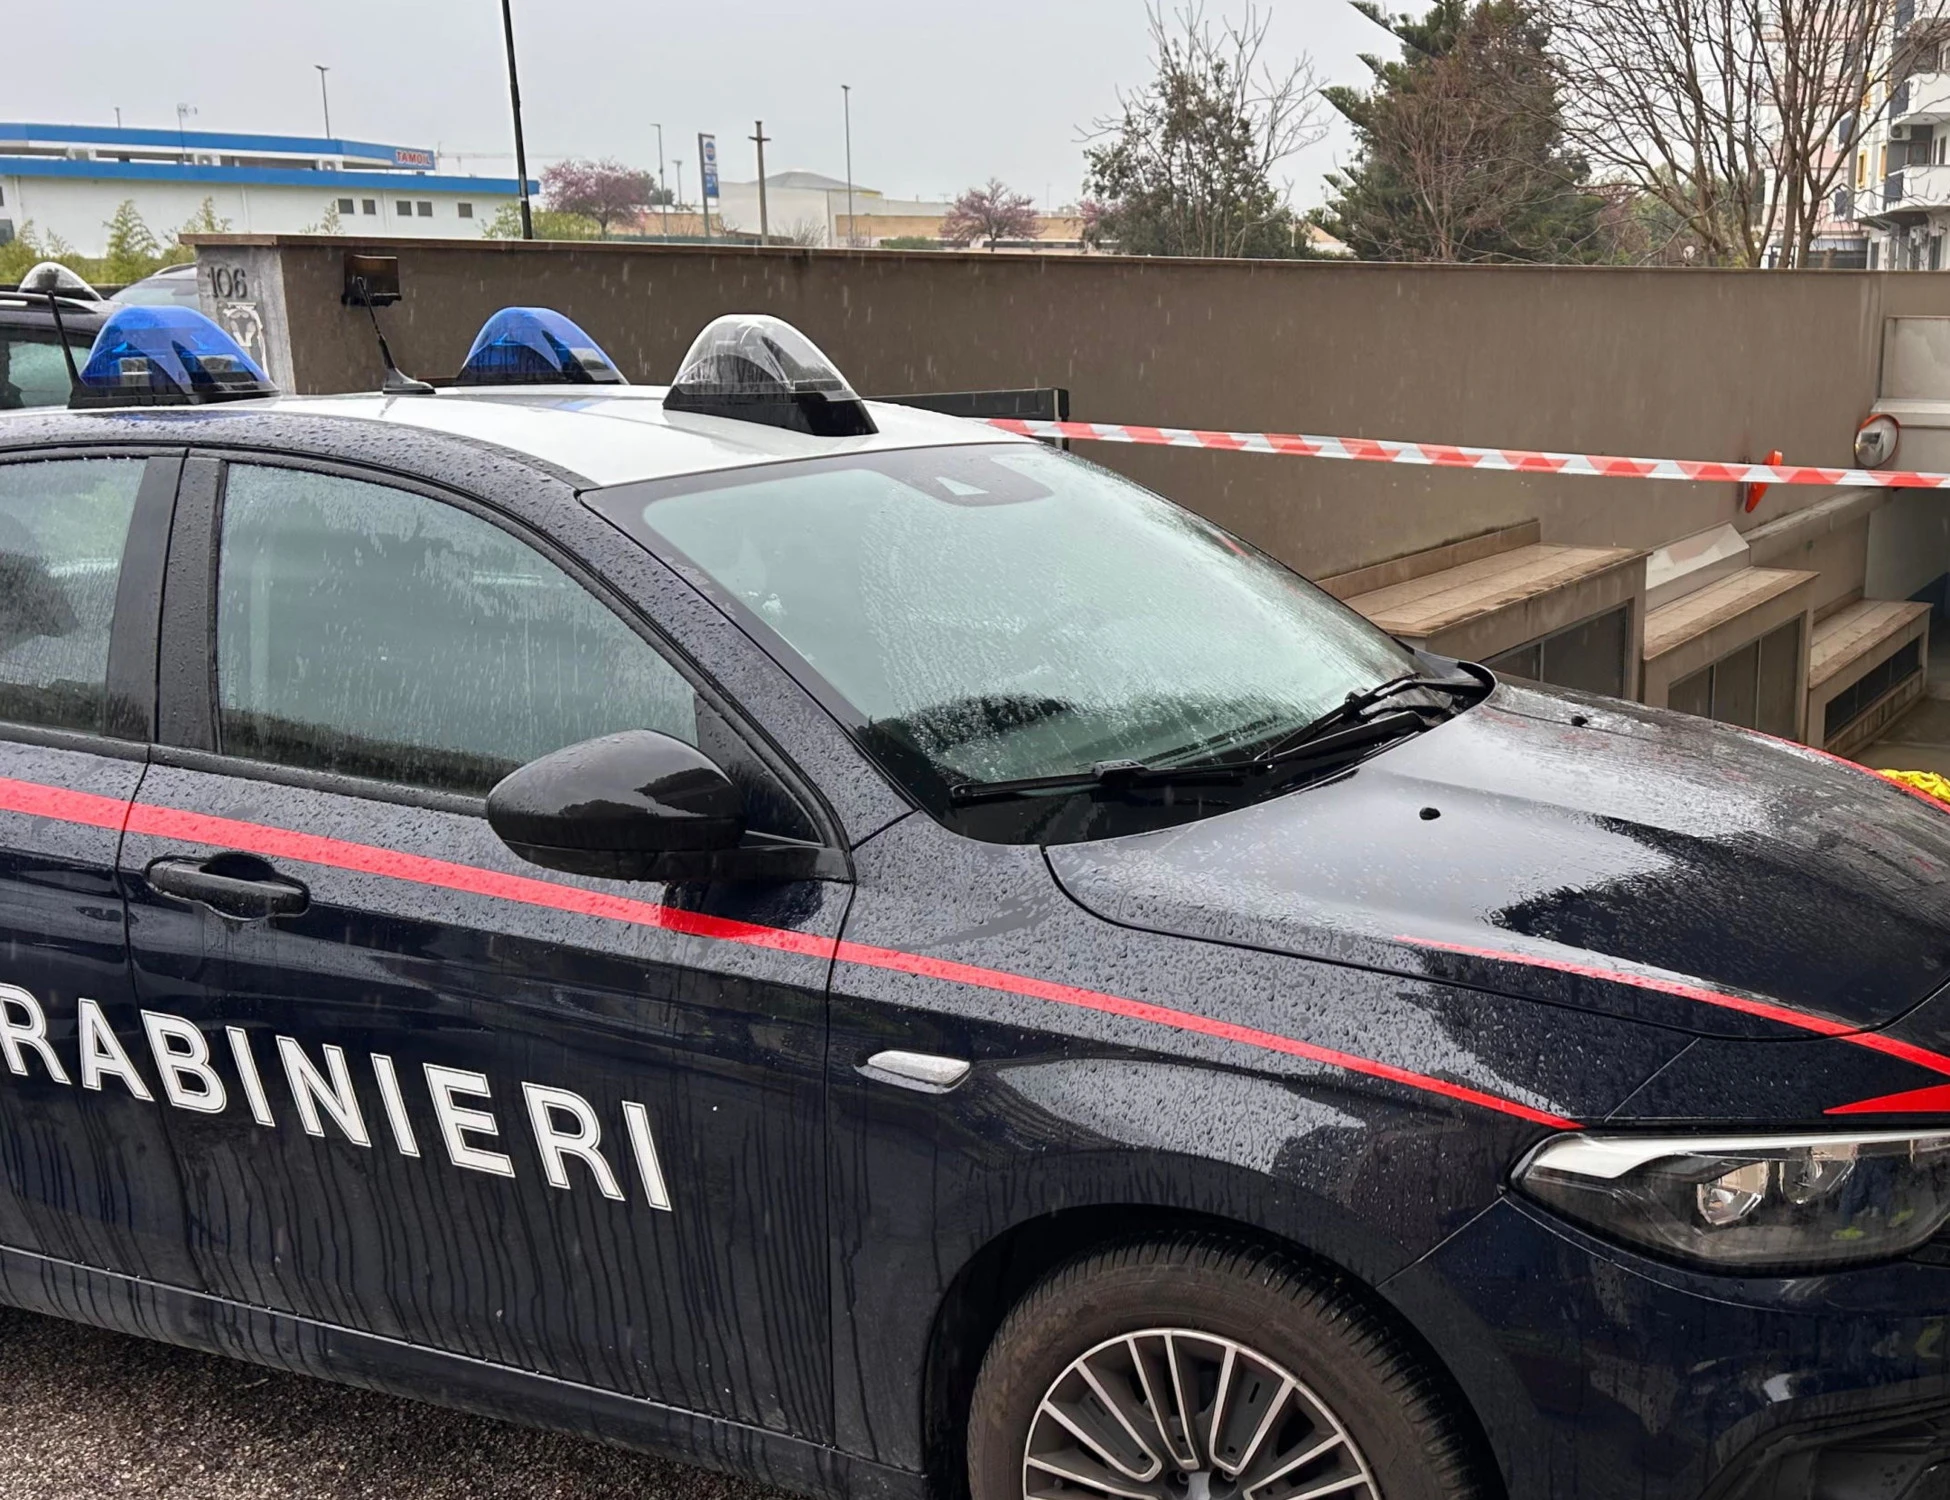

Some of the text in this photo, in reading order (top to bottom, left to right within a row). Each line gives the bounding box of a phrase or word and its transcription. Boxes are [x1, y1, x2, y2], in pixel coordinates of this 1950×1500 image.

[396, 150, 431, 165] TAMOIL
[207, 266, 248, 298] 106
[0, 982, 672, 1211] RABINIERI
